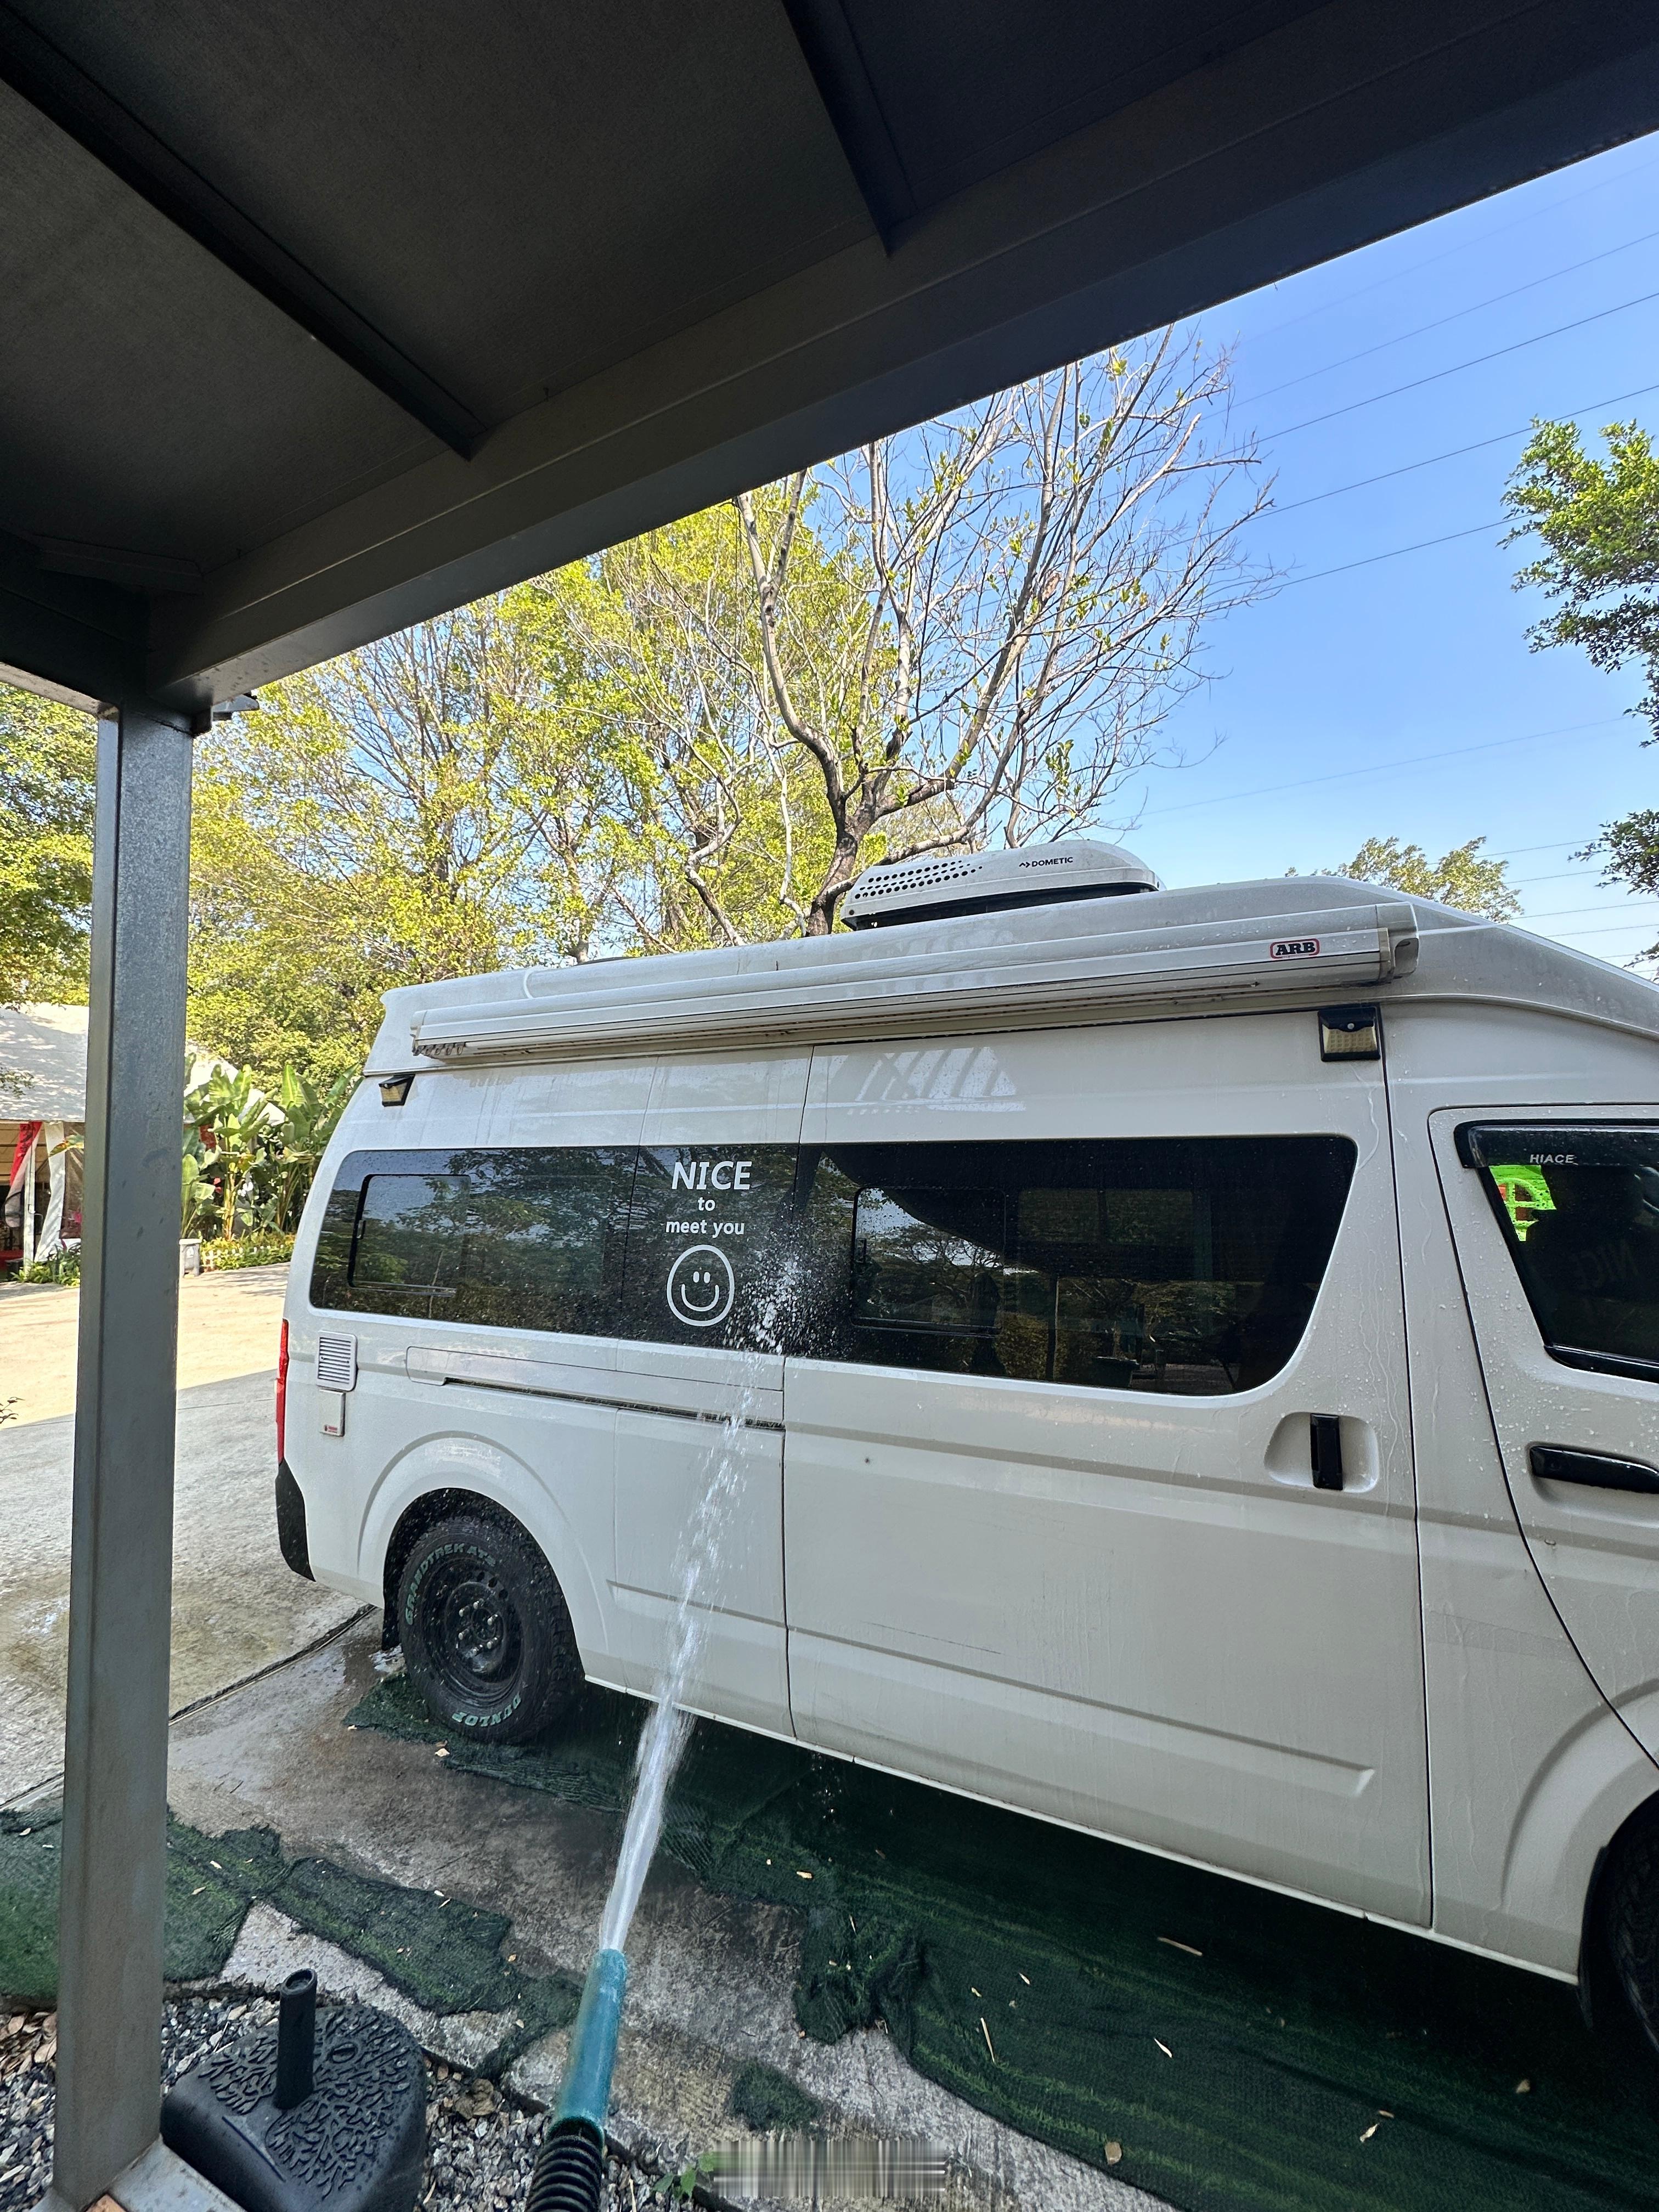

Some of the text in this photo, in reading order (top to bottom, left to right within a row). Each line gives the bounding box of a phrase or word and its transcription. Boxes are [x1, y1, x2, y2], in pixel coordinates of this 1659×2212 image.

[1031, 856, 1073, 867] DOMETIC
[1276, 942, 1316, 955] ARB
[1530, 1154, 1574, 1164] HIACE
[672, 1161, 752, 1190] NICE
[697, 1197, 716, 1211] to
[665, 1219, 746, 1238] meet you
[405, 1543, 465, 1626] GRANDTREK
[452, 1692, 521, 1727] DUNLOP
